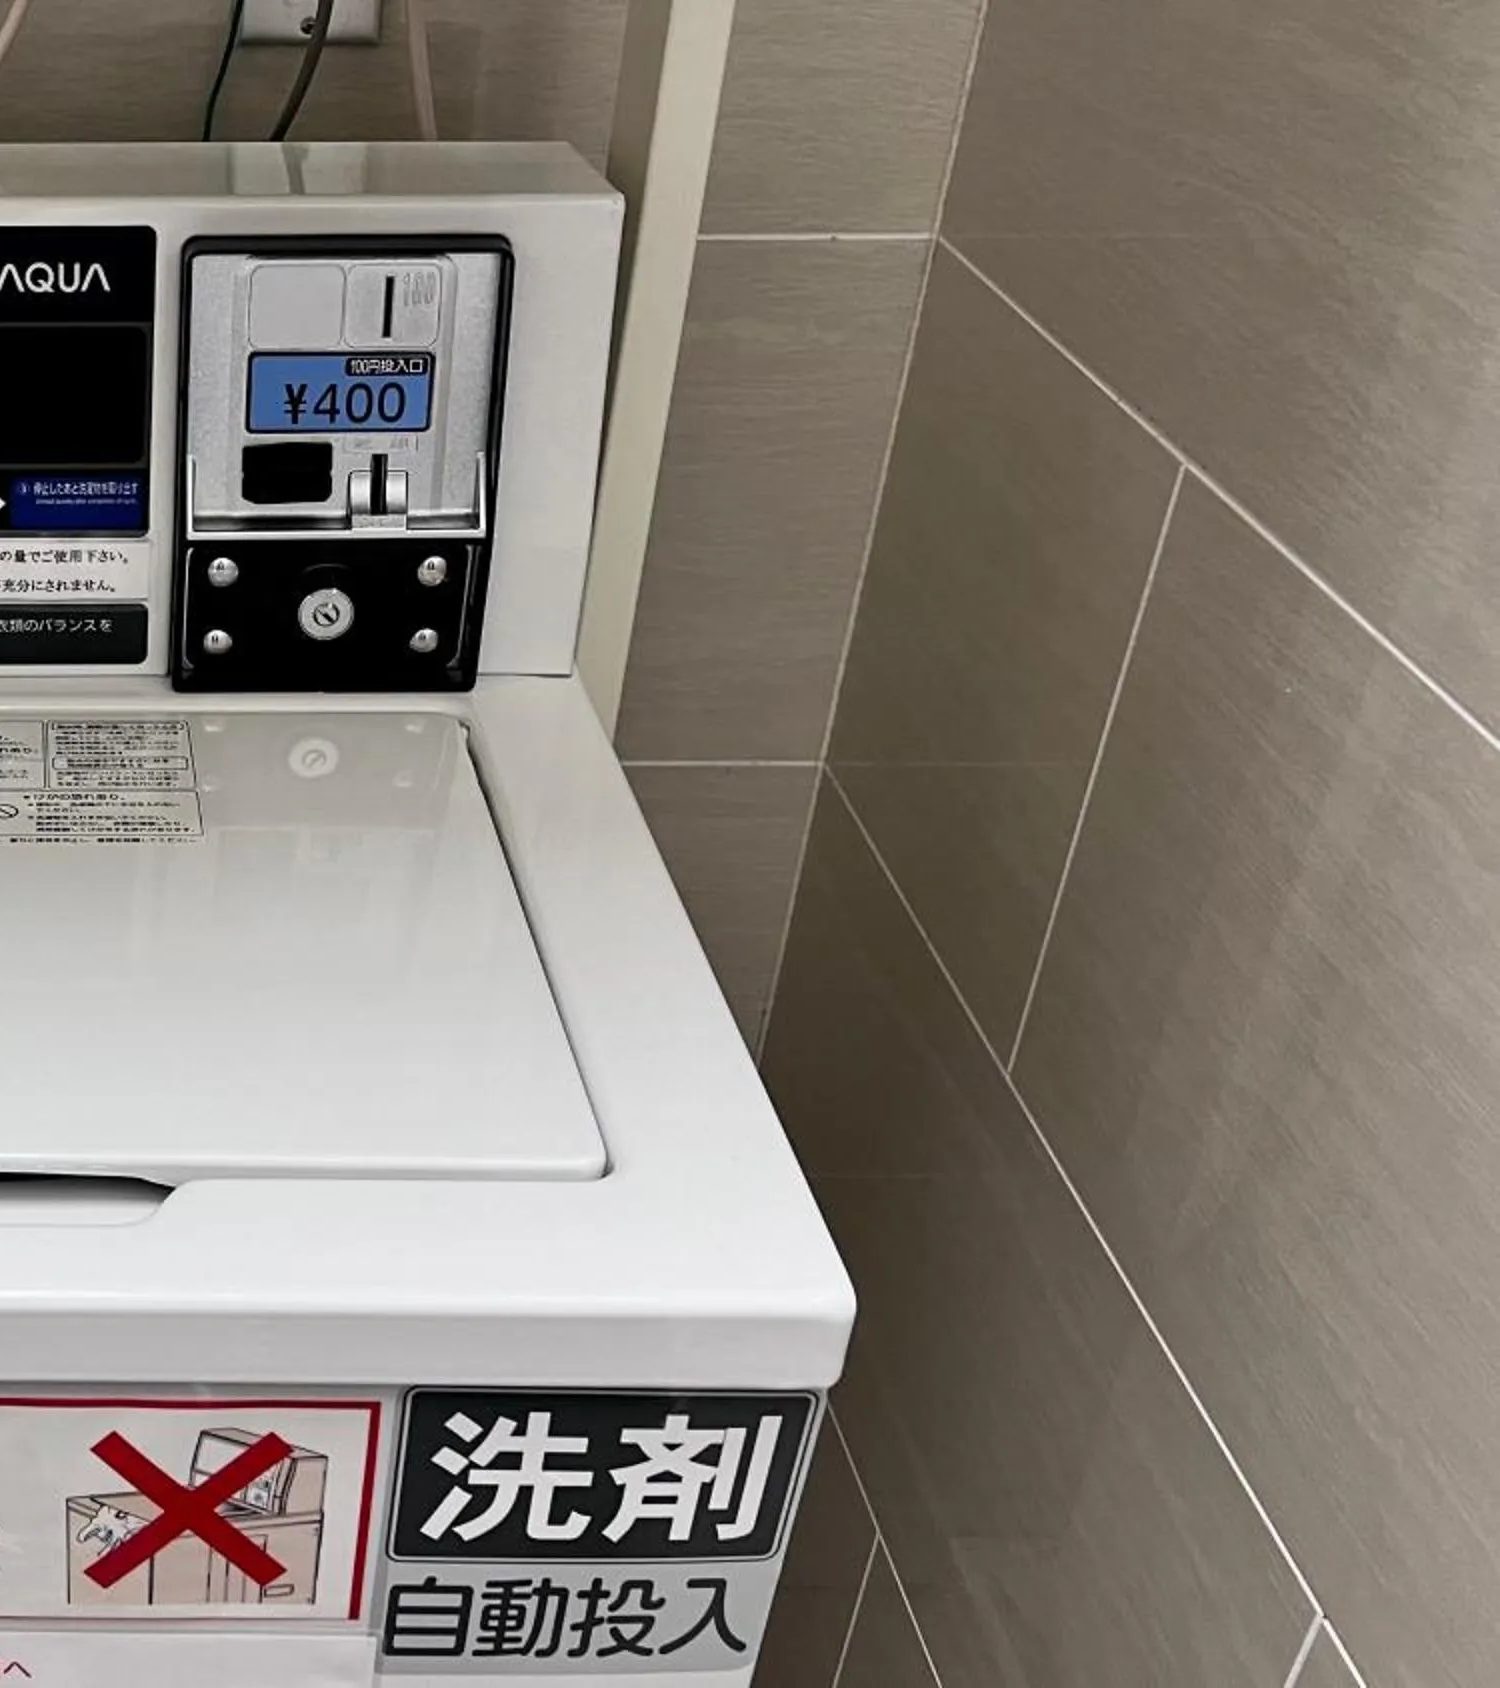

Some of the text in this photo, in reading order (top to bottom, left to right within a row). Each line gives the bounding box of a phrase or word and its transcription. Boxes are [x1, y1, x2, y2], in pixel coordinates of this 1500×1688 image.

[350, 358, 424, 374] 100円投入口
[283, 382, 406, 425] ¥400
[420, 1411, 784, 1543] 洗剤
[382, 1576, 747, 1658] 自動投入
